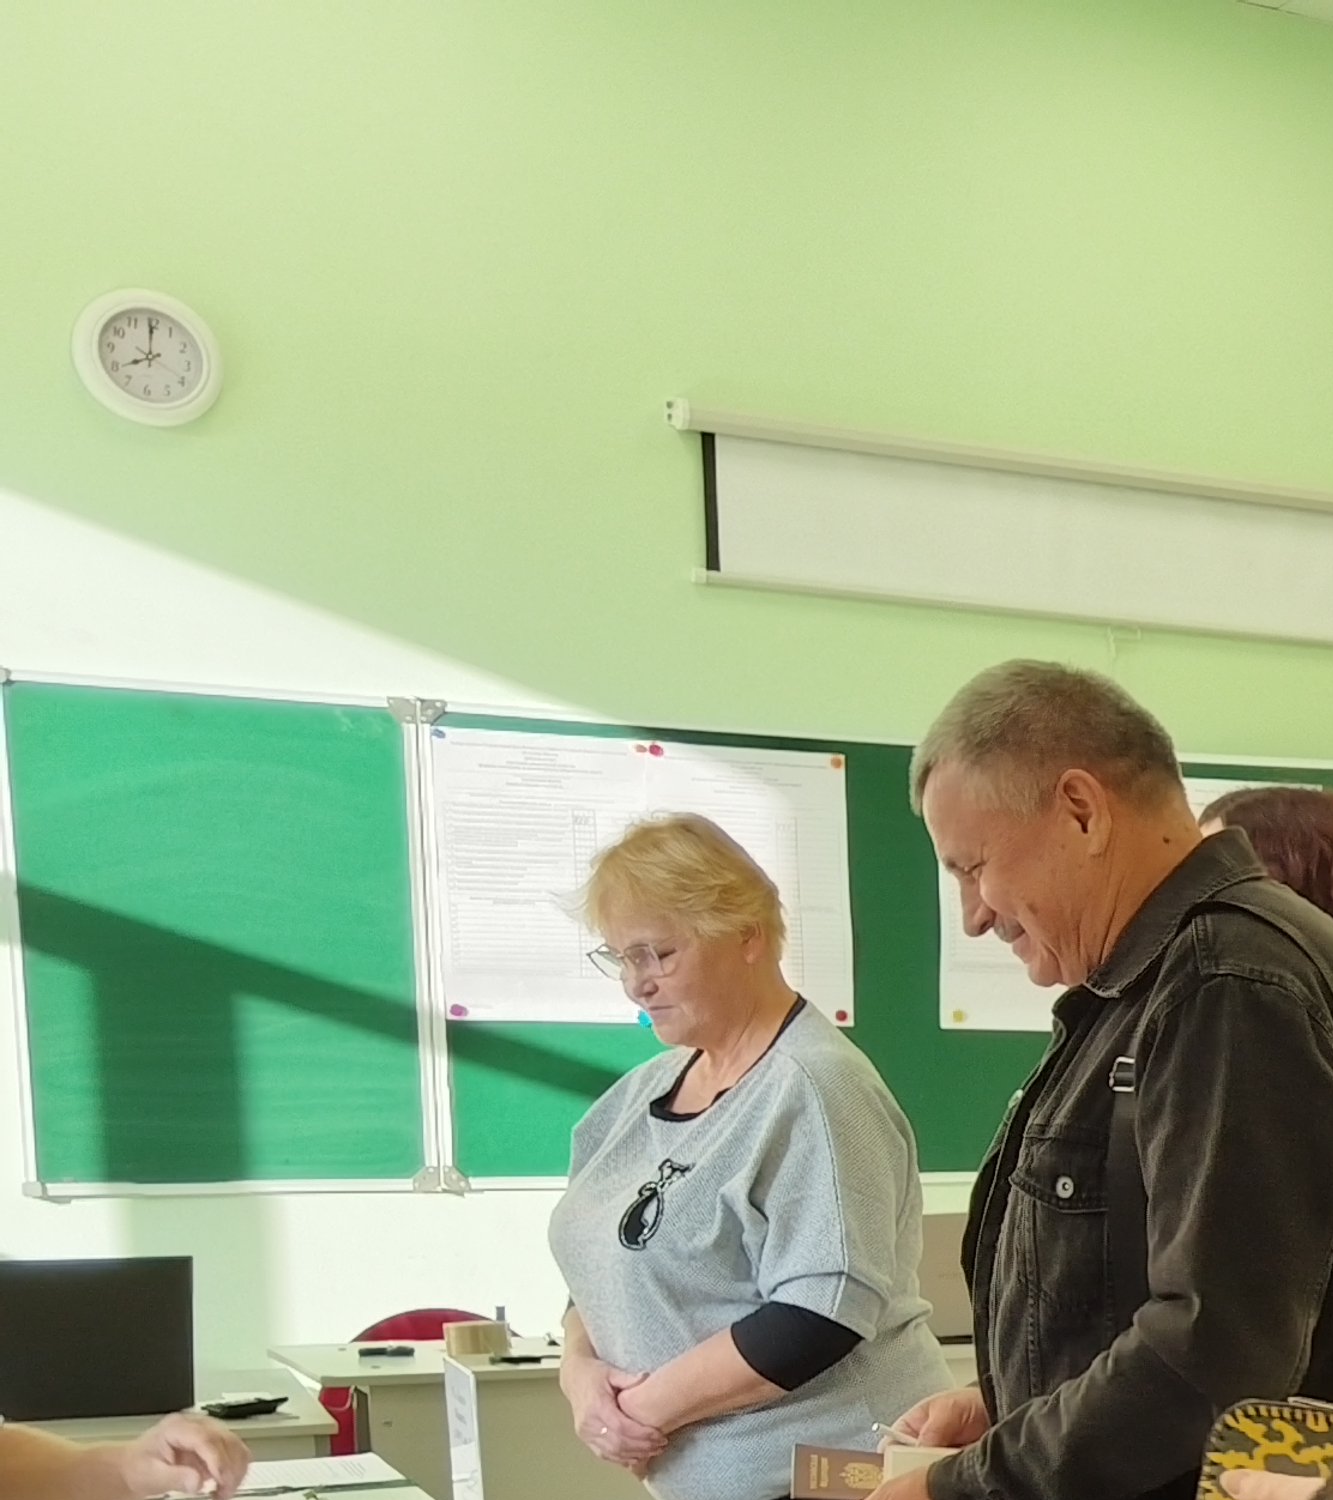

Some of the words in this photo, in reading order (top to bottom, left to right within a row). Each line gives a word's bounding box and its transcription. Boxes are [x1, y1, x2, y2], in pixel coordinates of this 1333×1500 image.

[127, 316, 138, 329] 11
[113, 325, 126, 339] 10
[168, 326, 173, 339] 1
[107, 342, 115, 353] 9
[179, 342, 187, 354] 2
[111, 361, 119, 373] 8
[184, 360, 191, 373] 3
[124, 375, 132, 386] 7
[143, 385, 151, 396] 6
[163, 384, 171, 396] 5
